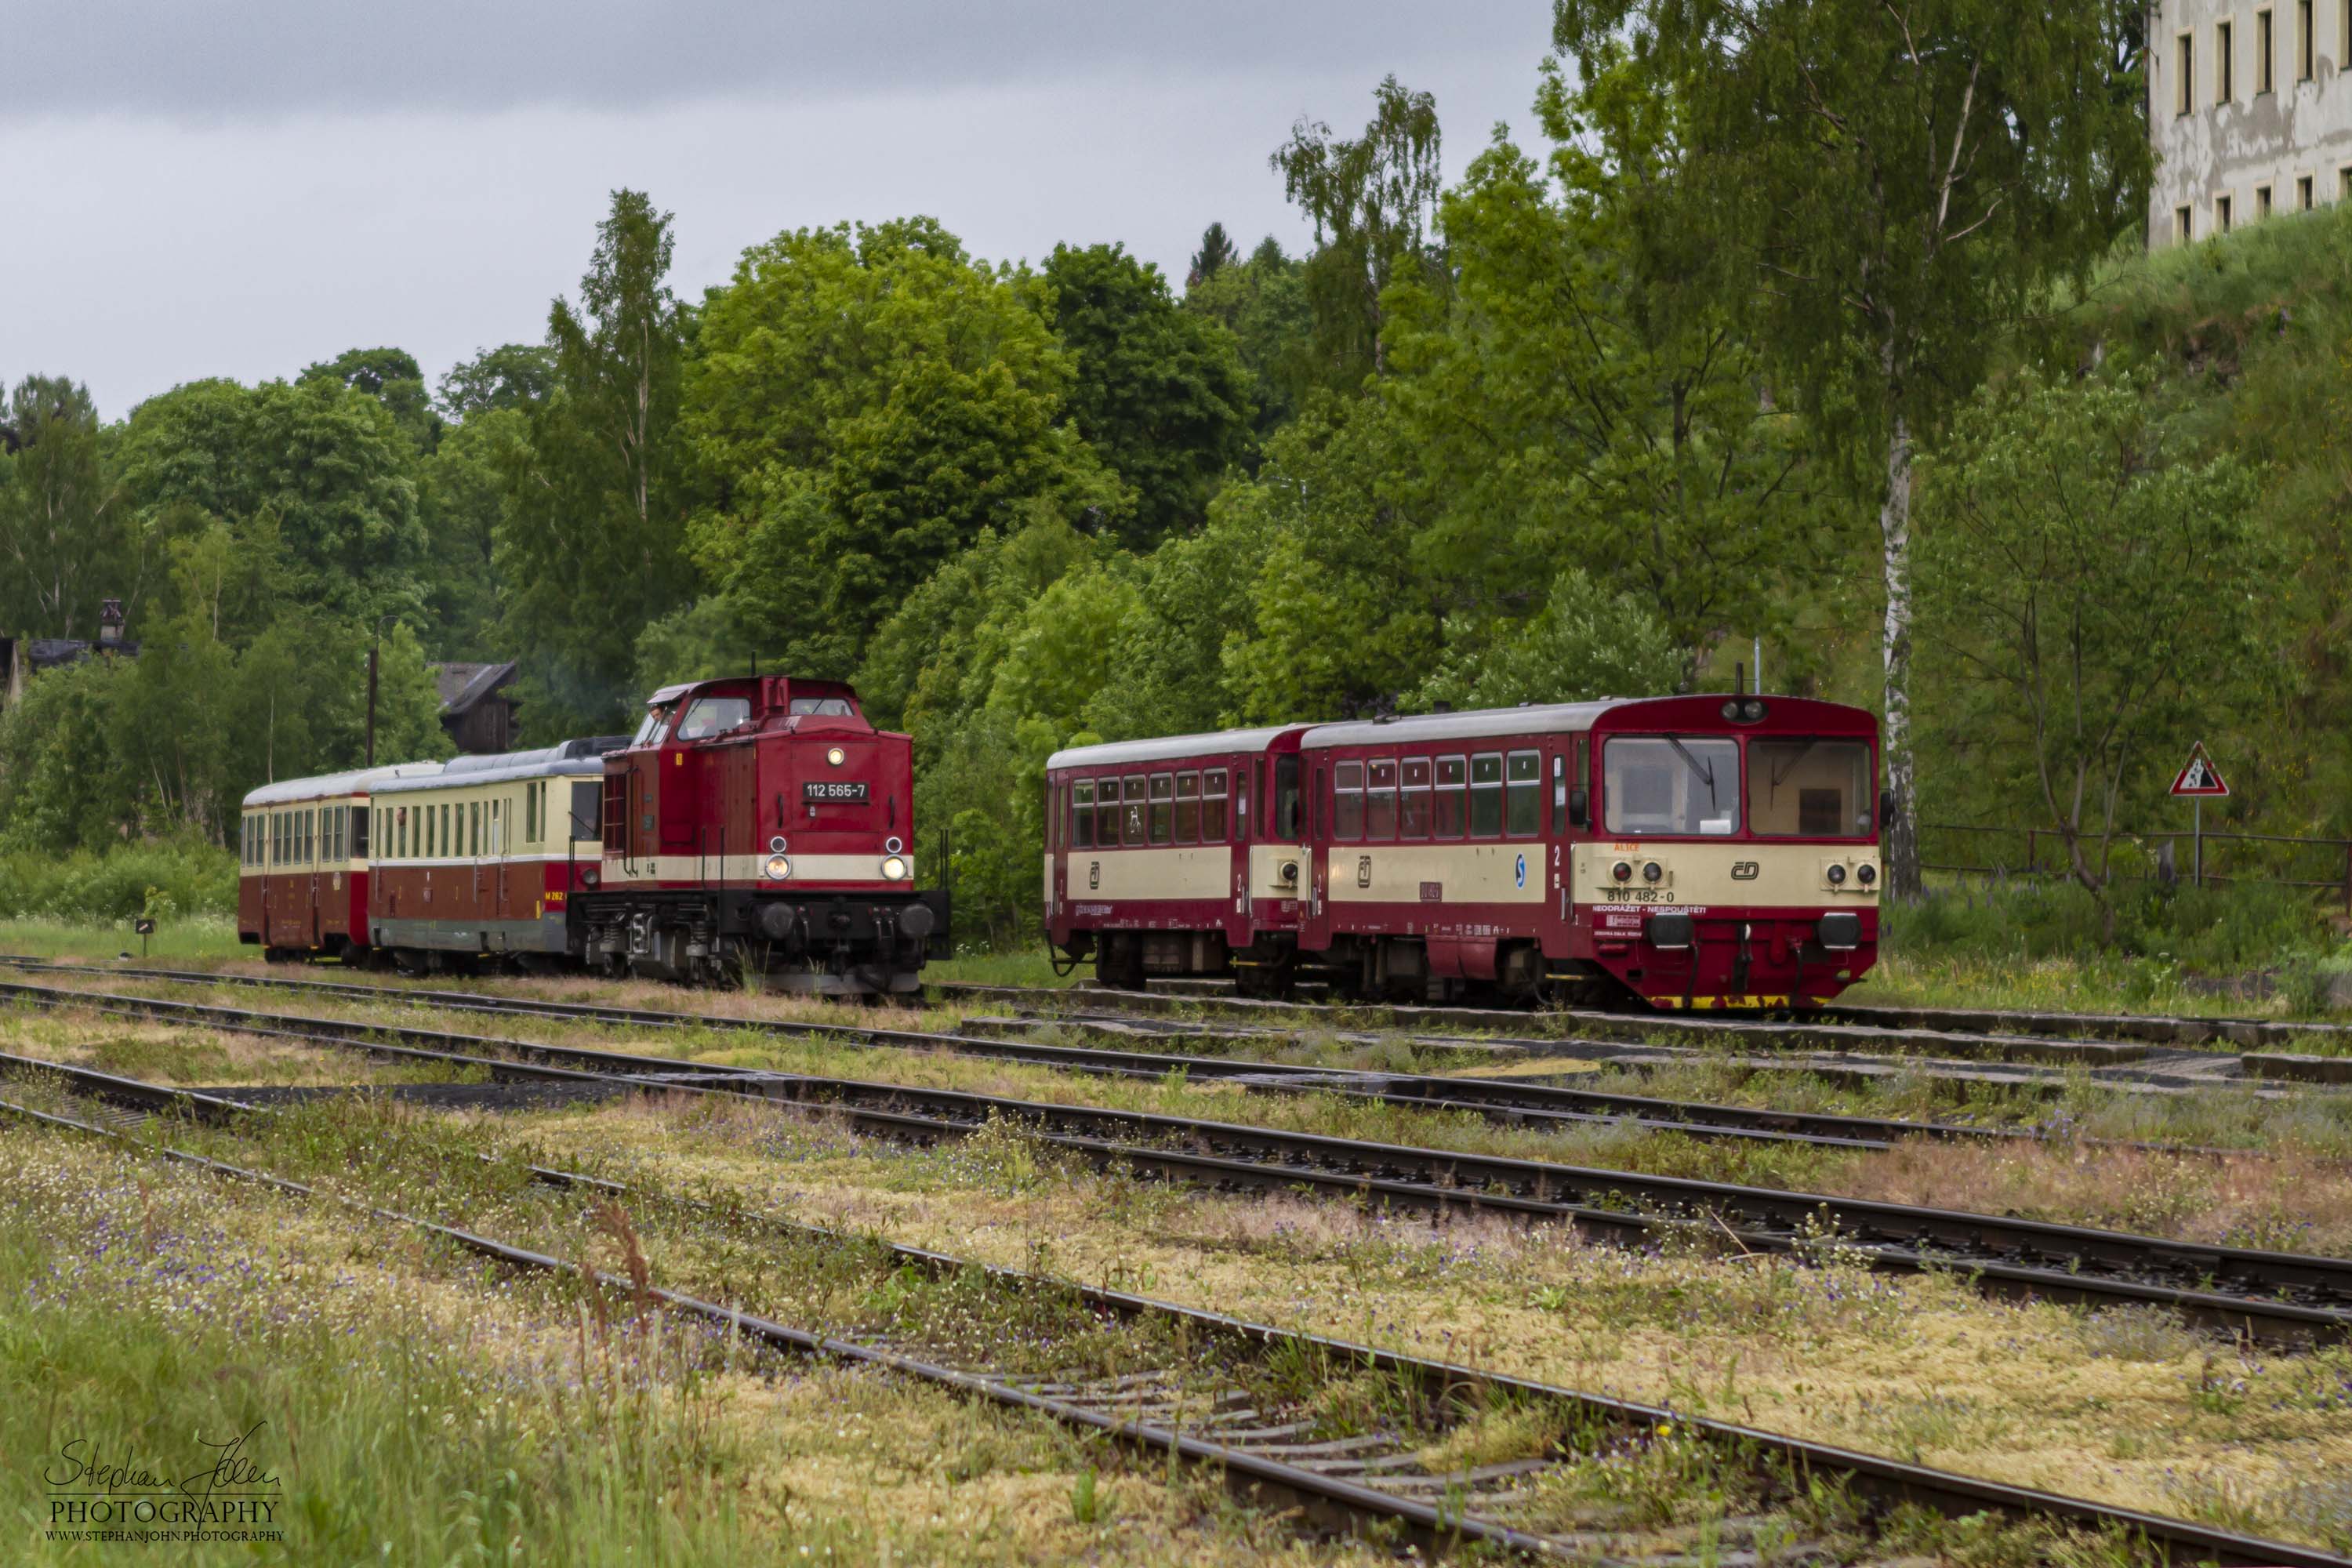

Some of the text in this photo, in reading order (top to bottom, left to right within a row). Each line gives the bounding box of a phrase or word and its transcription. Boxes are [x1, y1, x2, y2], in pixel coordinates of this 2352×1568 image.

[808, 784, 865, 797] 112 565-7
[1614, 843, 1640, 851] ALICE
[1554, 845, 1560, 866] 2
[1237, 874, 1242, 891] 2
[1607, 891, 1674, 902] 810 482-0
